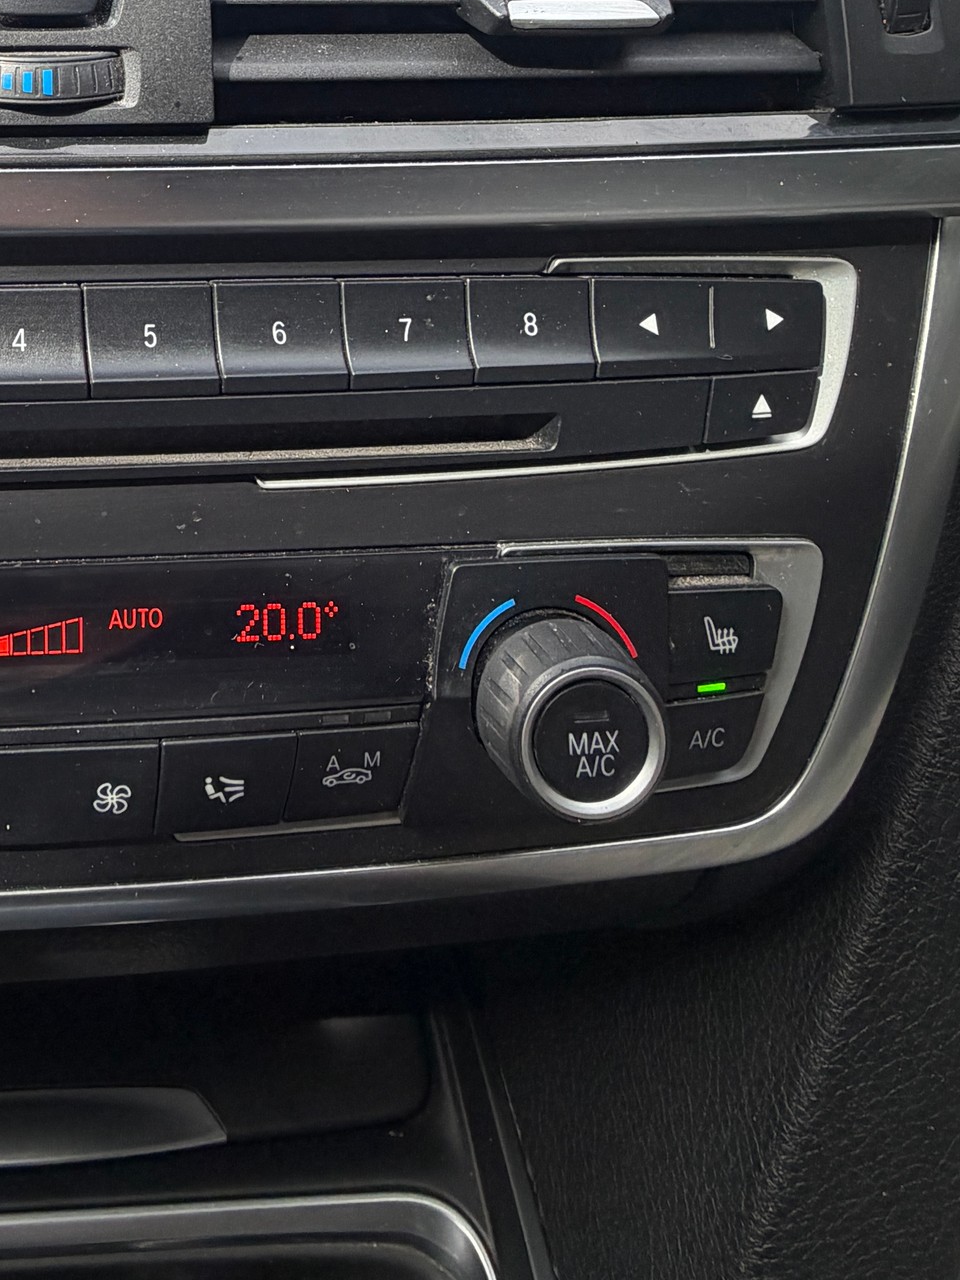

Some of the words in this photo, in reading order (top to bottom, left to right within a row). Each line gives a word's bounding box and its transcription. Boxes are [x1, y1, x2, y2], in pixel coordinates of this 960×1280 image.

[143, 324, 158, 348] 5
[271, 321, 287, 345] 6
[398, 318, 412, 342] 7
[523, 312, 539, 337] 8
[12, 328, 28, 352] 4
[108, 607, 164, 630] AUTO
[568, 730, 620, 755] MAX
[689, 728, 725, 749] A/C
[326, 756, 340, 771] A
[364, 751, 381, 768] M
[576, 756, 615, 778] A/C
